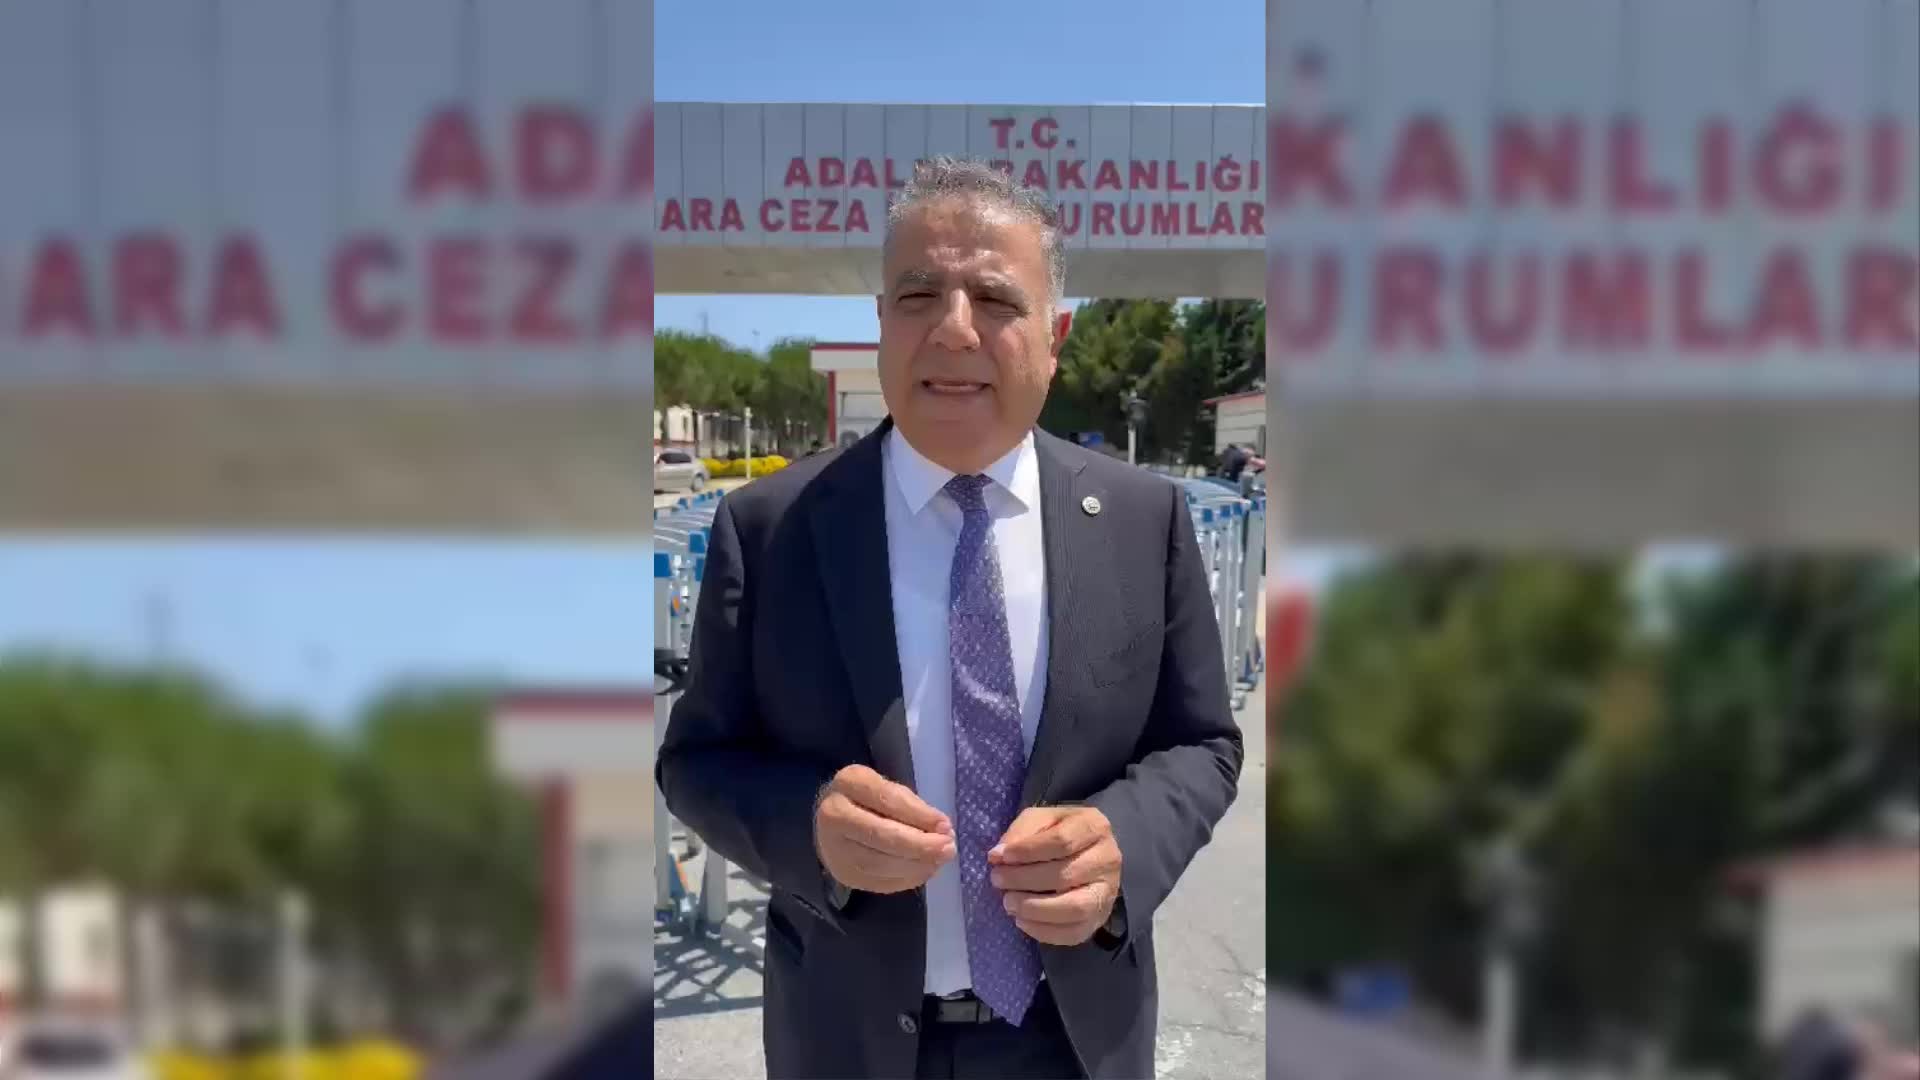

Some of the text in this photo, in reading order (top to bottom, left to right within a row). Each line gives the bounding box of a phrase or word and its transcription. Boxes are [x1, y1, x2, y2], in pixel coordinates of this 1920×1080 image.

[989, 118, 1076, 149] T.C.
[660, 198, 745, 232] ARA
[760, 198, 870, 233] CEZA
[21, 236, 654, 346] ARA CEZA
